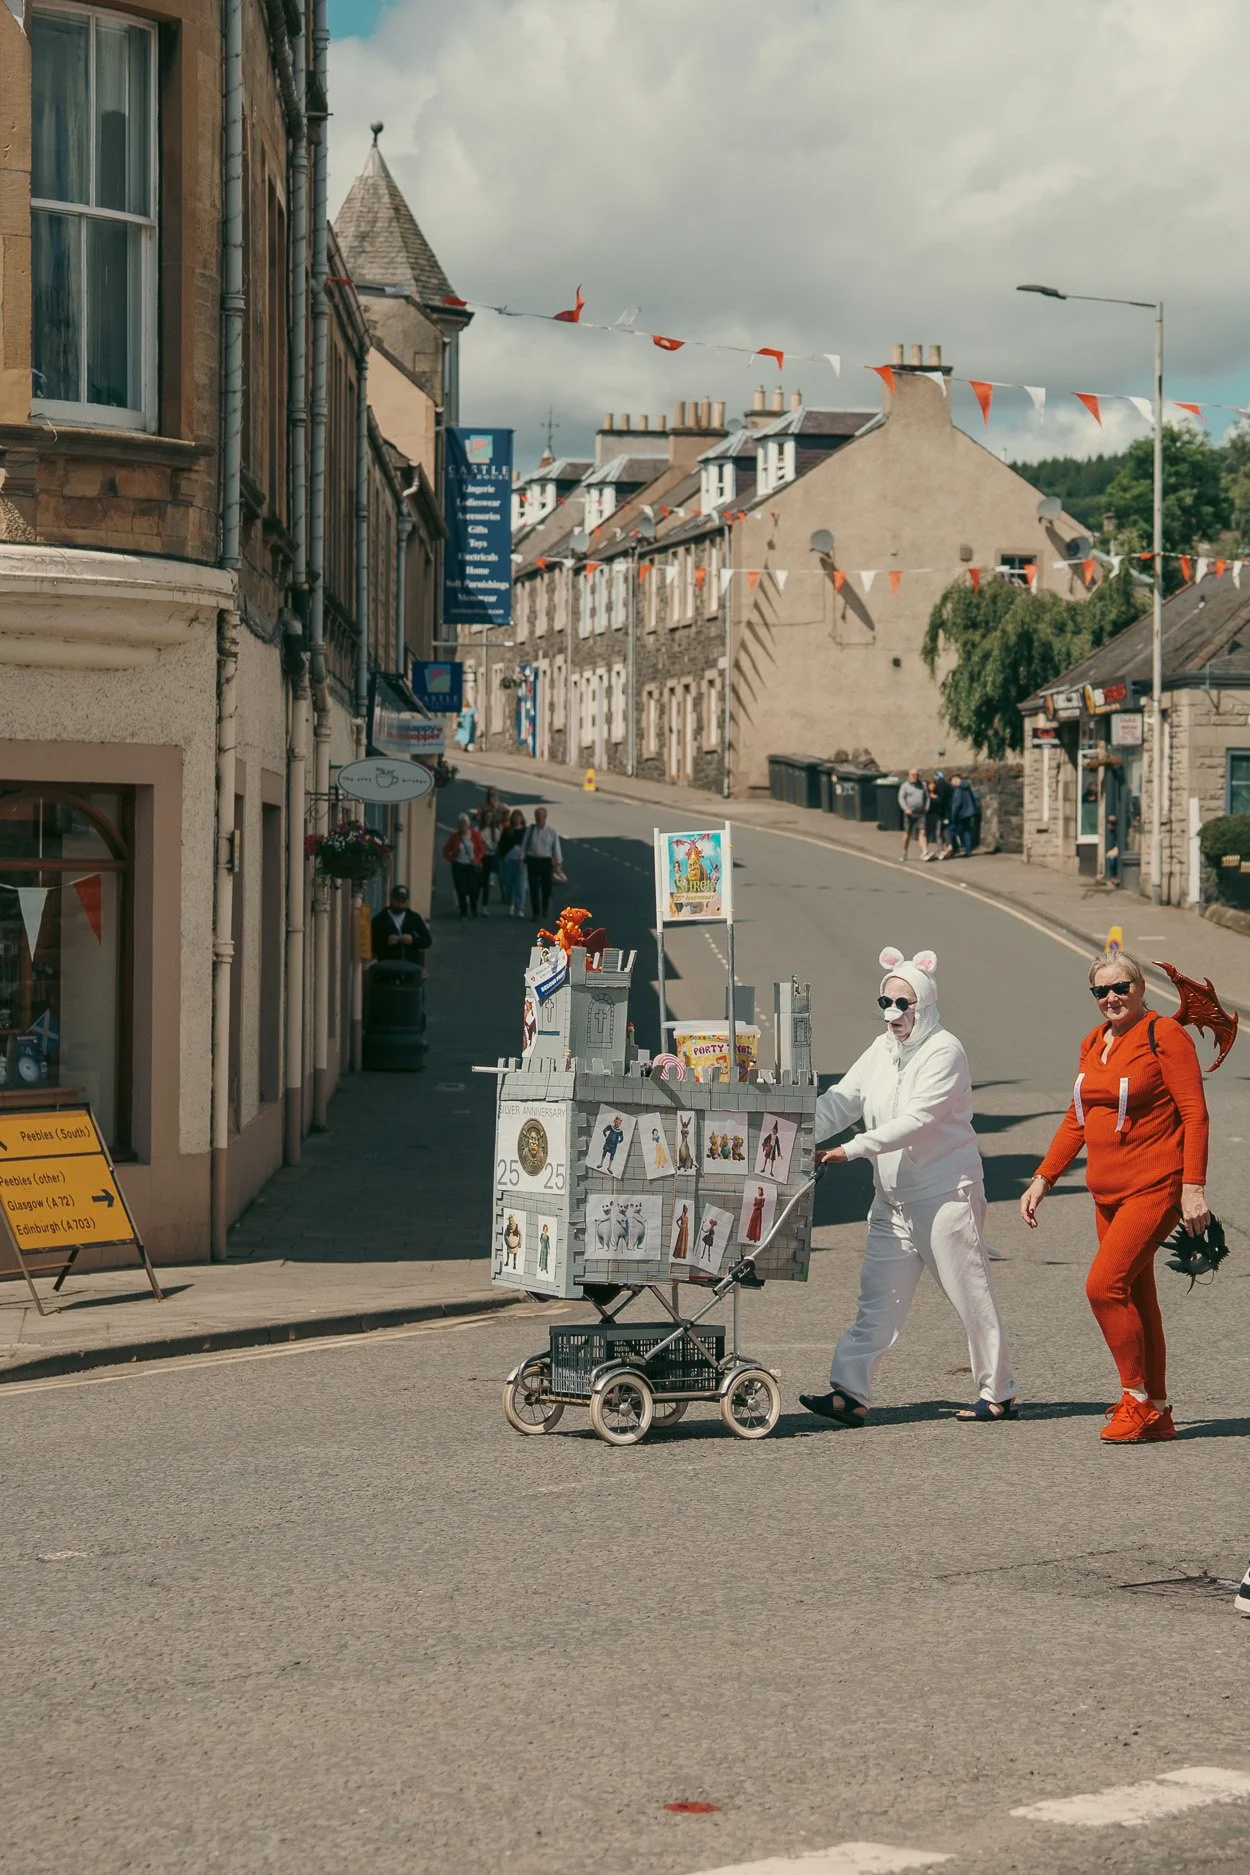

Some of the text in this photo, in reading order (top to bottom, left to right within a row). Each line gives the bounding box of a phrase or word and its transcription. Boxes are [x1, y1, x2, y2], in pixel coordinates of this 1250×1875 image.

[448, 465, 510, 476] CASTLE
[462, 483, 496, 494] Lingerie
[456, 497, 502, 507] Ladieswear
[456, 511, 501, 521] Accessories
[467, 524, 489, 534] Gifts
[467, 538, 488, 548] Toys
[465, 566, 490, 575] Home
[463, 578, 510, 591] Furnishings
[693, 1044, 724, 1056] PARTY
[499, 1104, 566, 1118] SILVER ANNIVERSARY
[20, 1125, 91, 1142] Peebles (South)
[497, 1158, 520, 1187] 25
[543, 1162, 566, 1190] 25
[0, 1171, 66, 1187] Peebles (other)
[7, 1197, 44, 1212] Glasgow
[16, 1220, 60, 1236] Edinburgh
